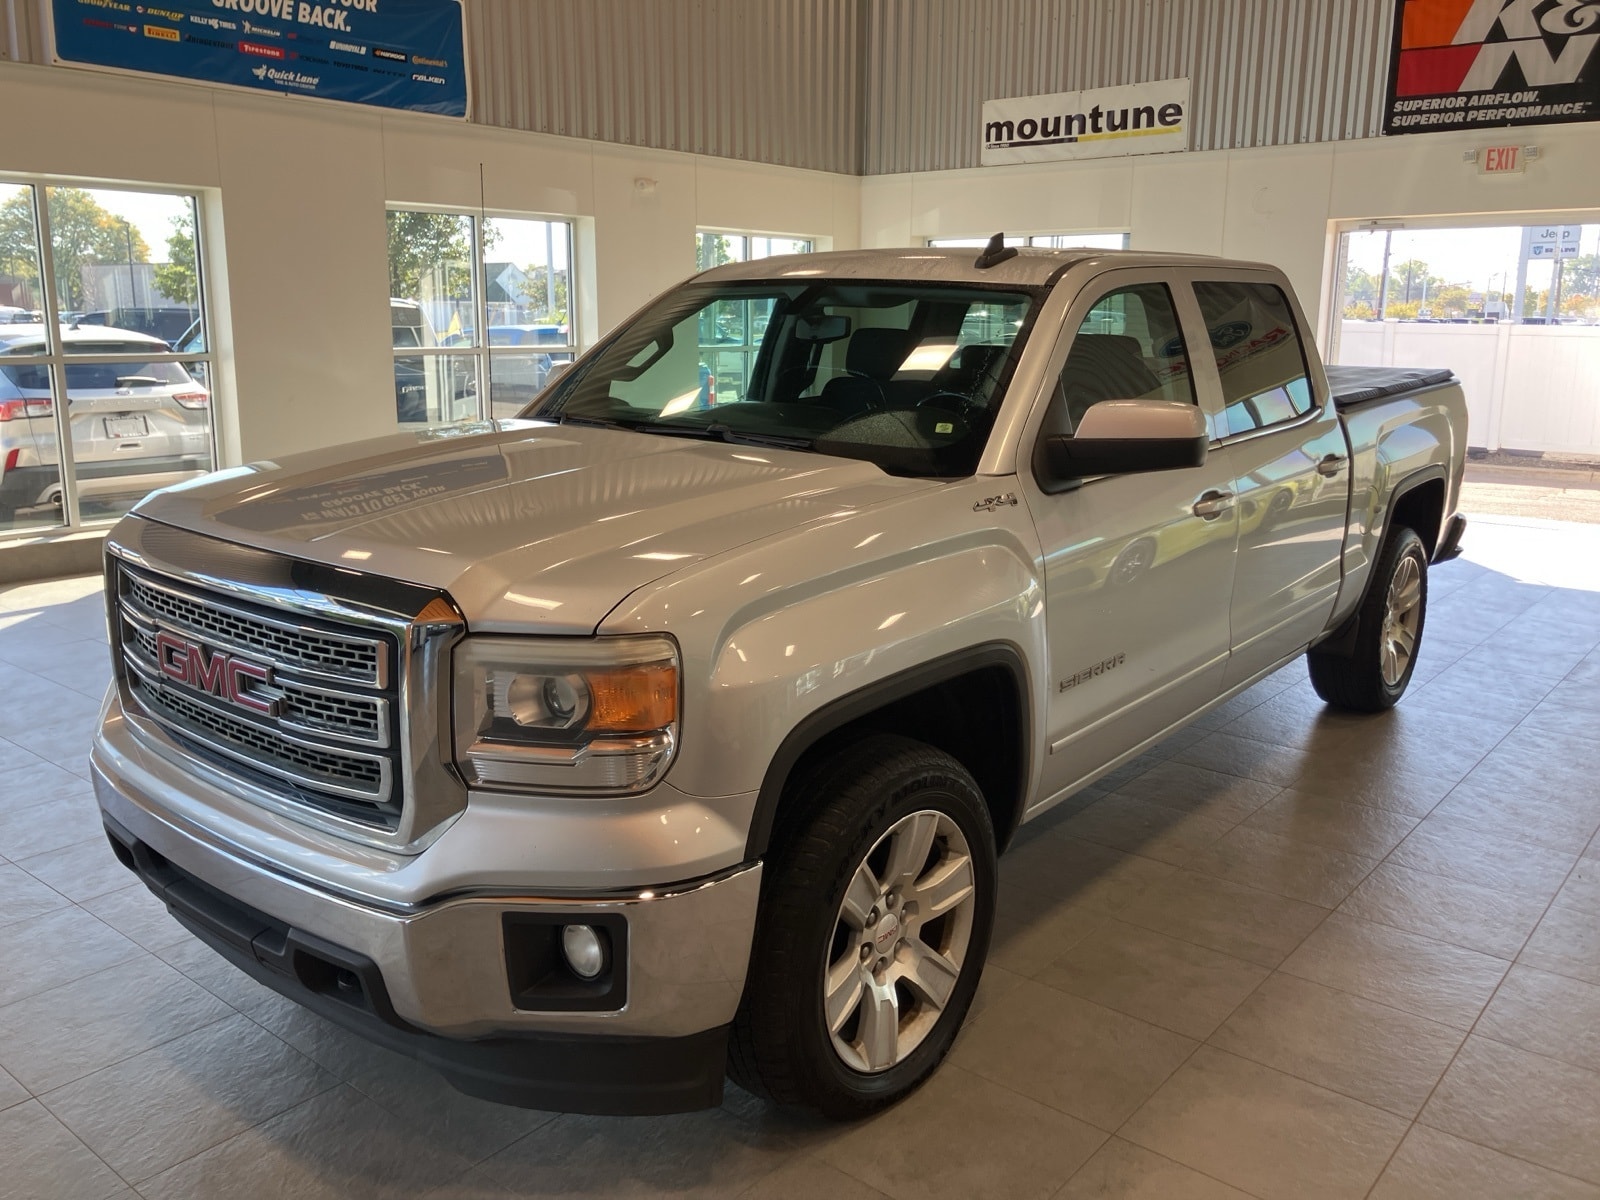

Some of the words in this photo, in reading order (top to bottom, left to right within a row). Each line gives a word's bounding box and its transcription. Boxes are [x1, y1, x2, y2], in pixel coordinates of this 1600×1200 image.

[147, 8, 184, 19] DUNLOP
[297, 3, 351, 32] BACK.
[251, 26, 280, 37] MICHELIN
[243, 44, 280, 57] Firestone
[267, 68, 295, 81] Quick
[296, 72, 319, 85] Lane
[412, 73, 445, 85] FALKEN
[1393, 96, 1468, 112] SUPERIOR
[1468, 90, 1540, 107] AIRFLOW.
[985, 102, 1184, 142] mountune
[1391, 111, 1466, 127] SUPERIOR
[1485, 147, 1520, 171] EXIT
[1541, 228, 1571, 239] Jep
[157, 630, 284, 717] GMC
[1059, 650, 1127, 693] SIERRA
